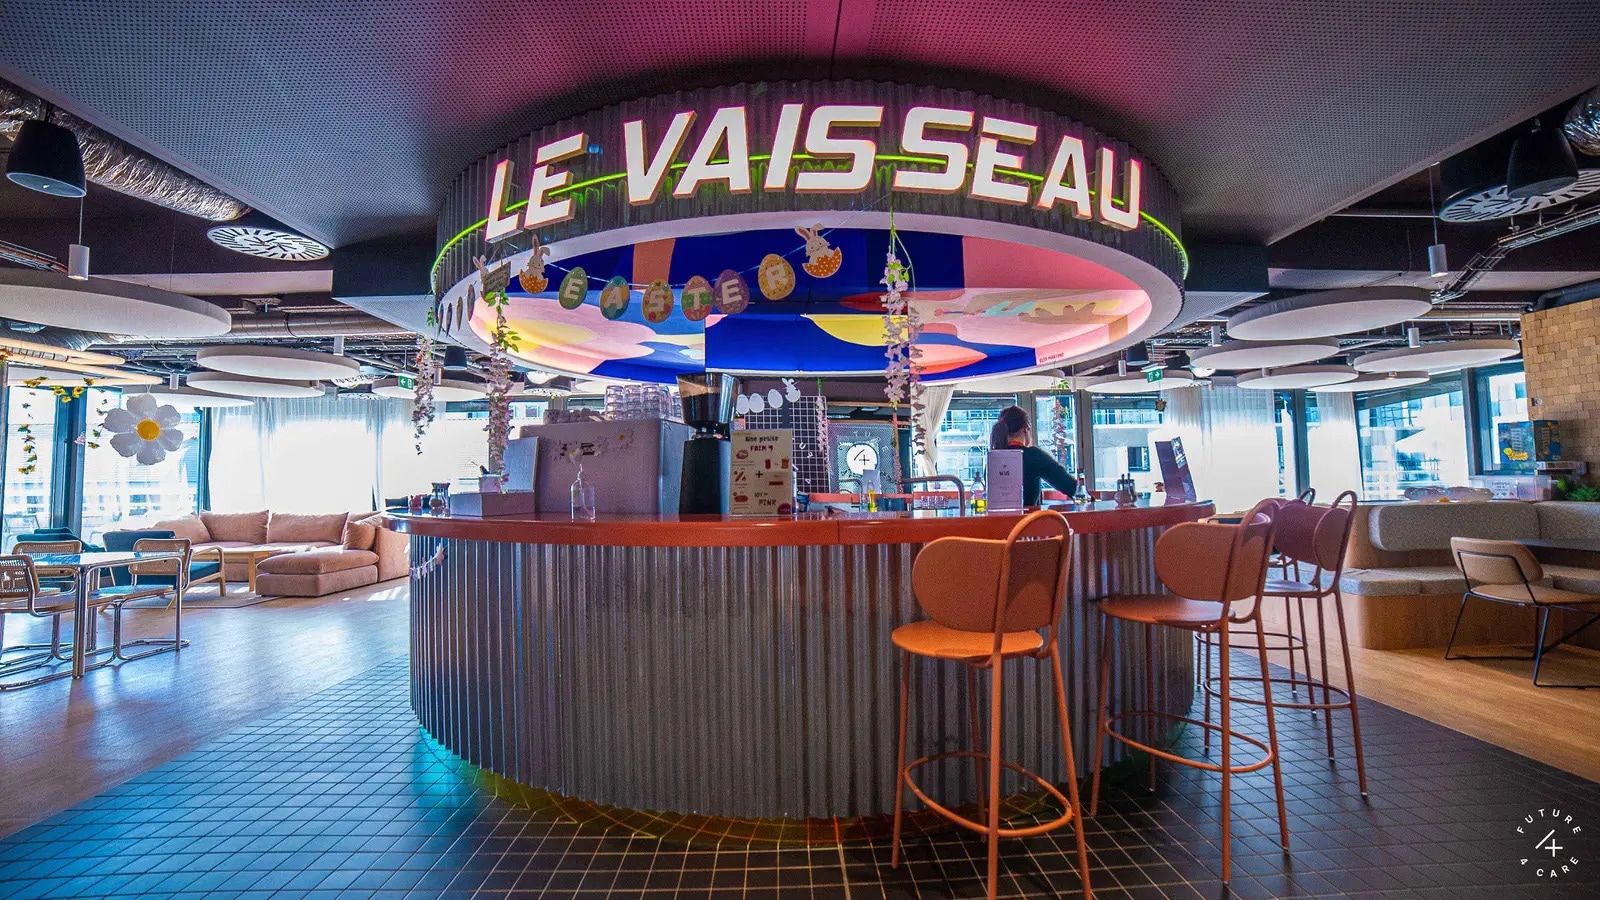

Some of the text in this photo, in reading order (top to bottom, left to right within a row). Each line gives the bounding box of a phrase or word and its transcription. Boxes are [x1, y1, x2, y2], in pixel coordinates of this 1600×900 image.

[485, 103, 1142, 243] LE VAISSEAU
[563, 263, 788, 312] EASTER
